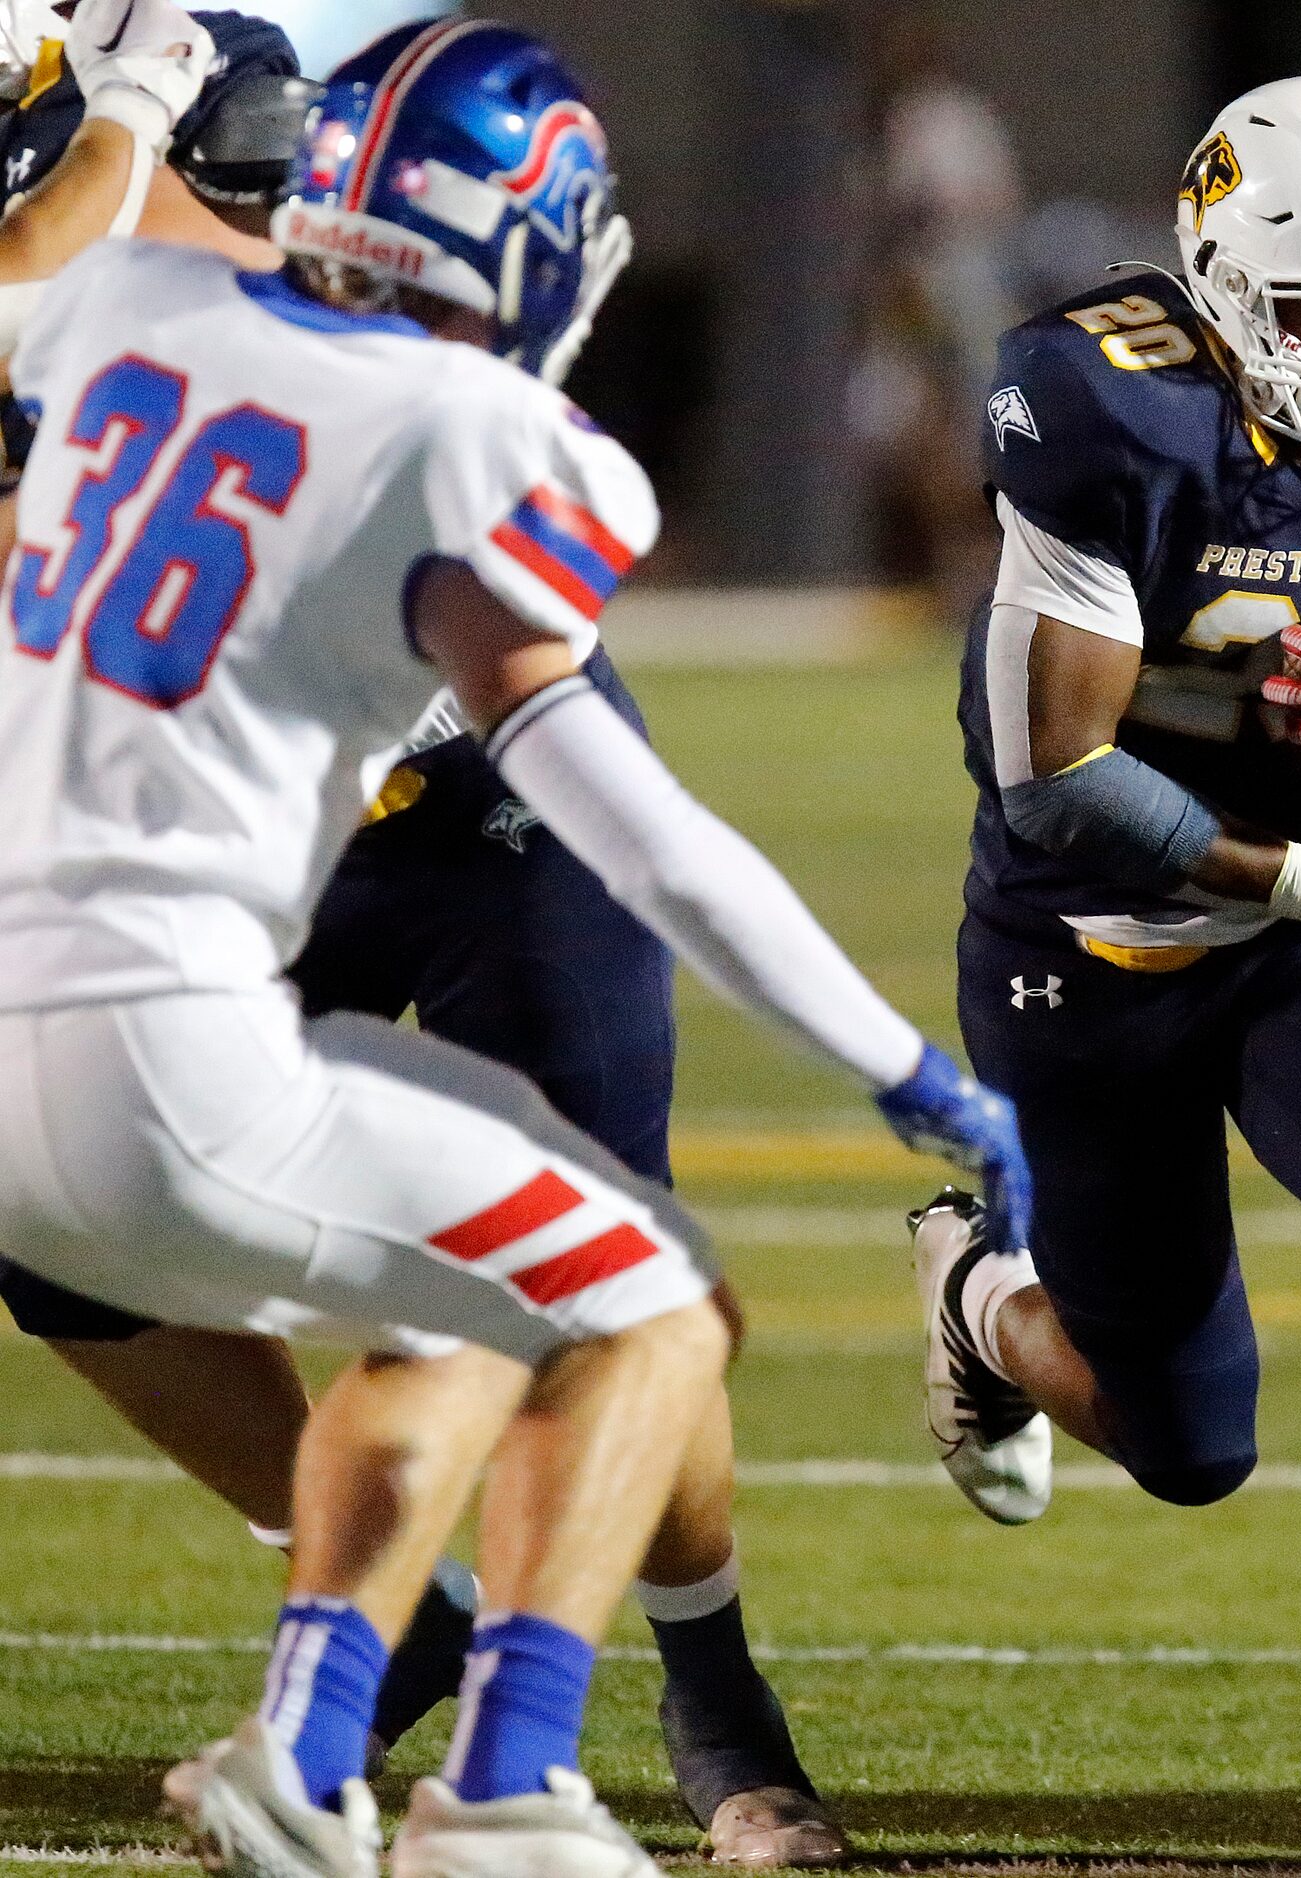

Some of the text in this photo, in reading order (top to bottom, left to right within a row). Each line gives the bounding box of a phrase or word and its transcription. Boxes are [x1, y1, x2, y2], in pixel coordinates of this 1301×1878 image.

[289, 211, 425, 278] Riddell
[1064, 294, 1197, 371] 20
[8, 351, 308, 712] 36
